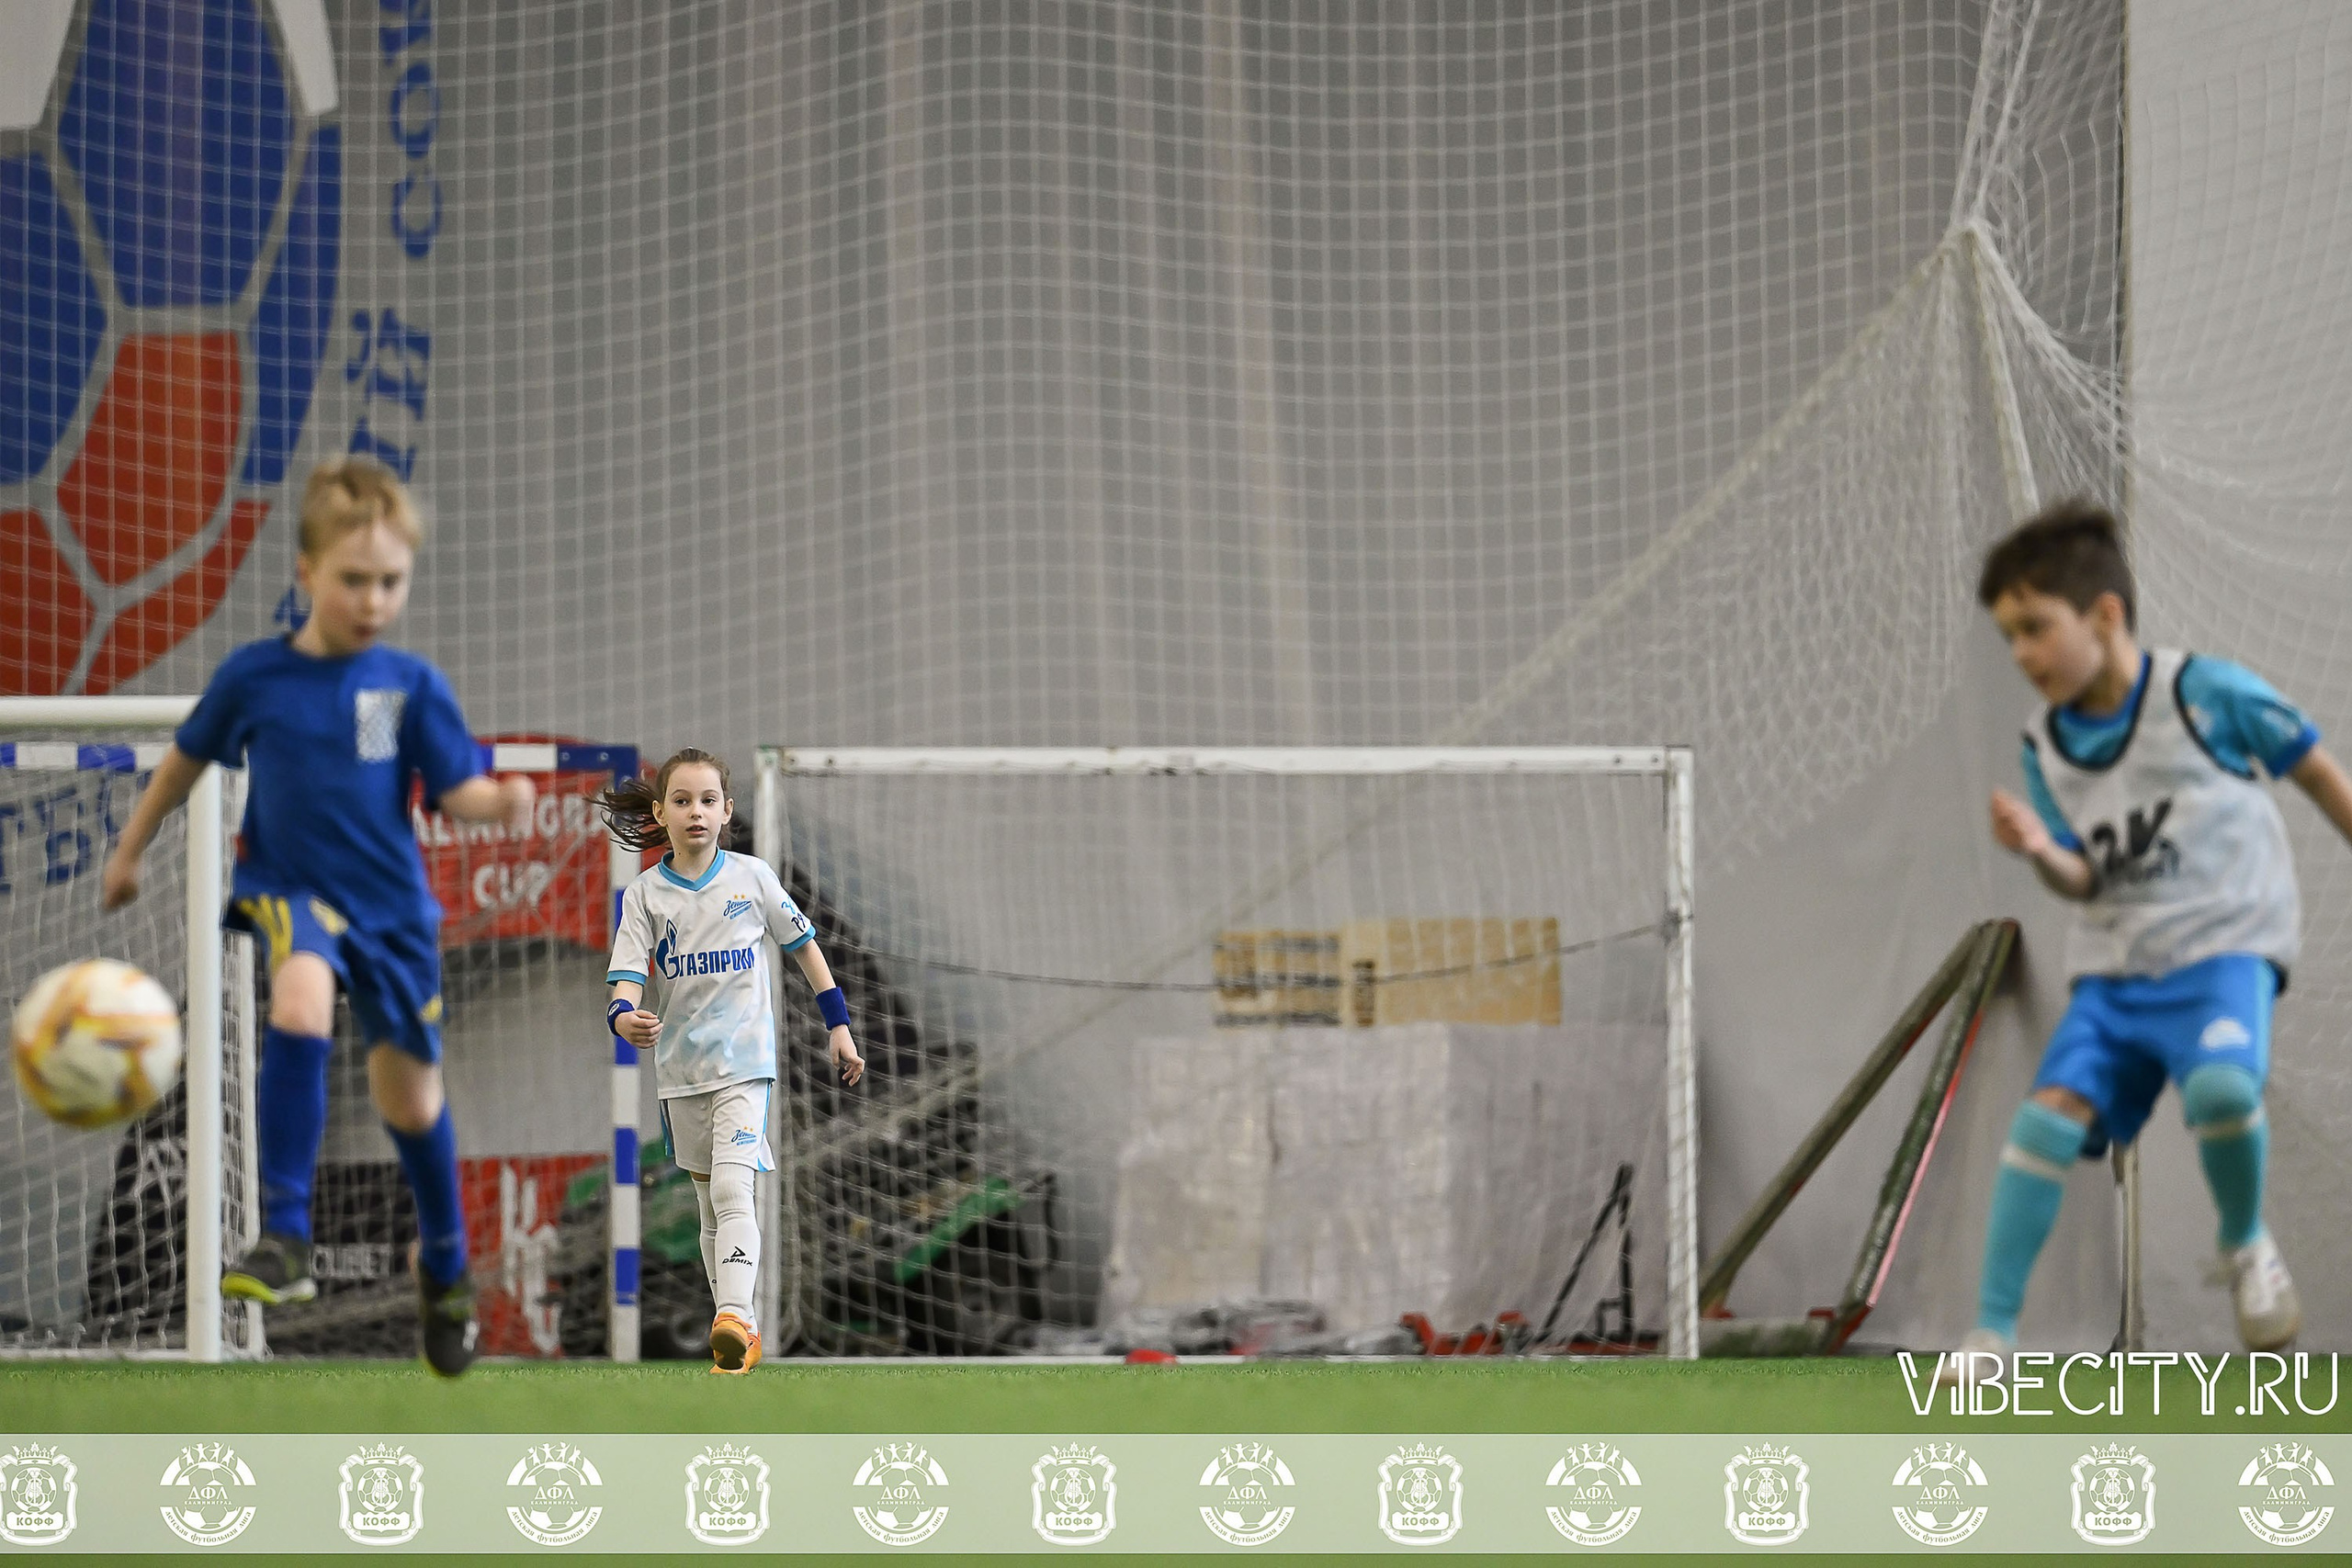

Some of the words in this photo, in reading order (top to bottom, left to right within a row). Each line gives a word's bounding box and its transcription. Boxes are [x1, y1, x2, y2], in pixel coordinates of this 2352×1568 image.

[471, 861, 550, 910] CUP
[678, 947, 755, 977] ГАЗПРОМ
[721, 1258, 753, 1267] DEMIX
